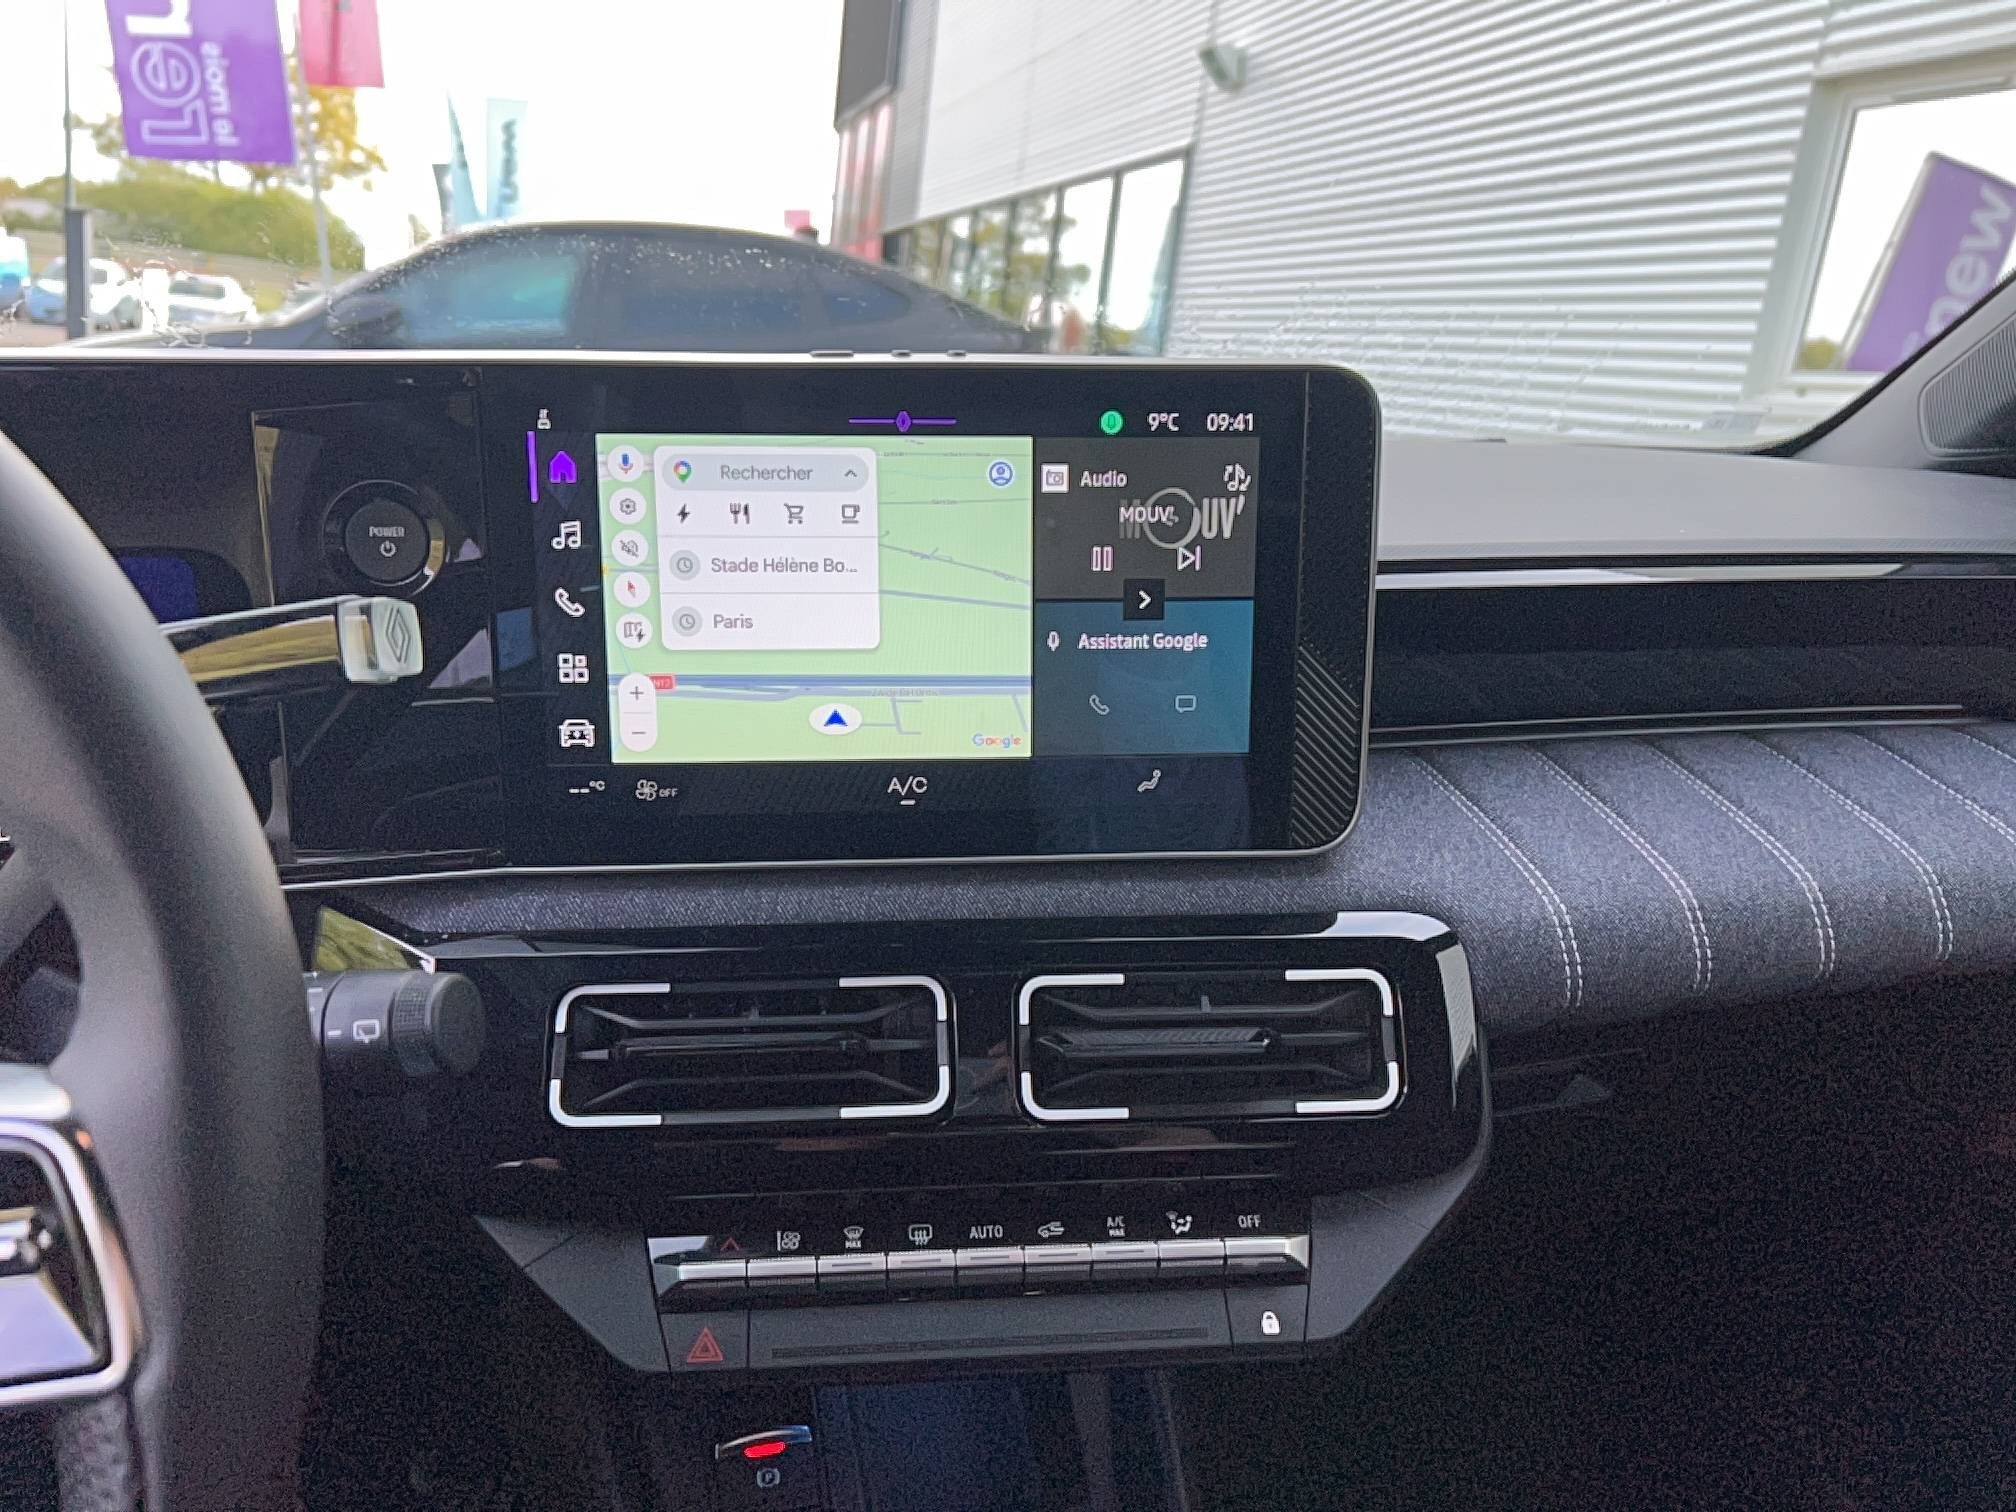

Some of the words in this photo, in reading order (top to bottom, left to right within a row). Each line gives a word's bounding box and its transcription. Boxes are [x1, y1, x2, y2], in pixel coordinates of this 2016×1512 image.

[1147, 412, 1180, 432] 9°C
[1206, 412, 1254, 432] 09:41
[720, 464, 814, 481] Rechercher
[1080, 470, 1128, 488] Audio
[369, 526, 405, 538] POWER
[711, 556, 759, 573] Stade
[763, 555, 819, 573] Hélène
[713, 613, 754, 629] Paris
[1078, 633, 1150, 650] Assistant
[1152, 632, 1209, 652] Google
[972, 732, 1022, 749] Google
[659, 787, 679, 798] OFF
[887, 775, 928, 796] A/C
[1237, 1214, 1262, 1228] OFF
[969, 1223, 1004, 1240] AUTO
